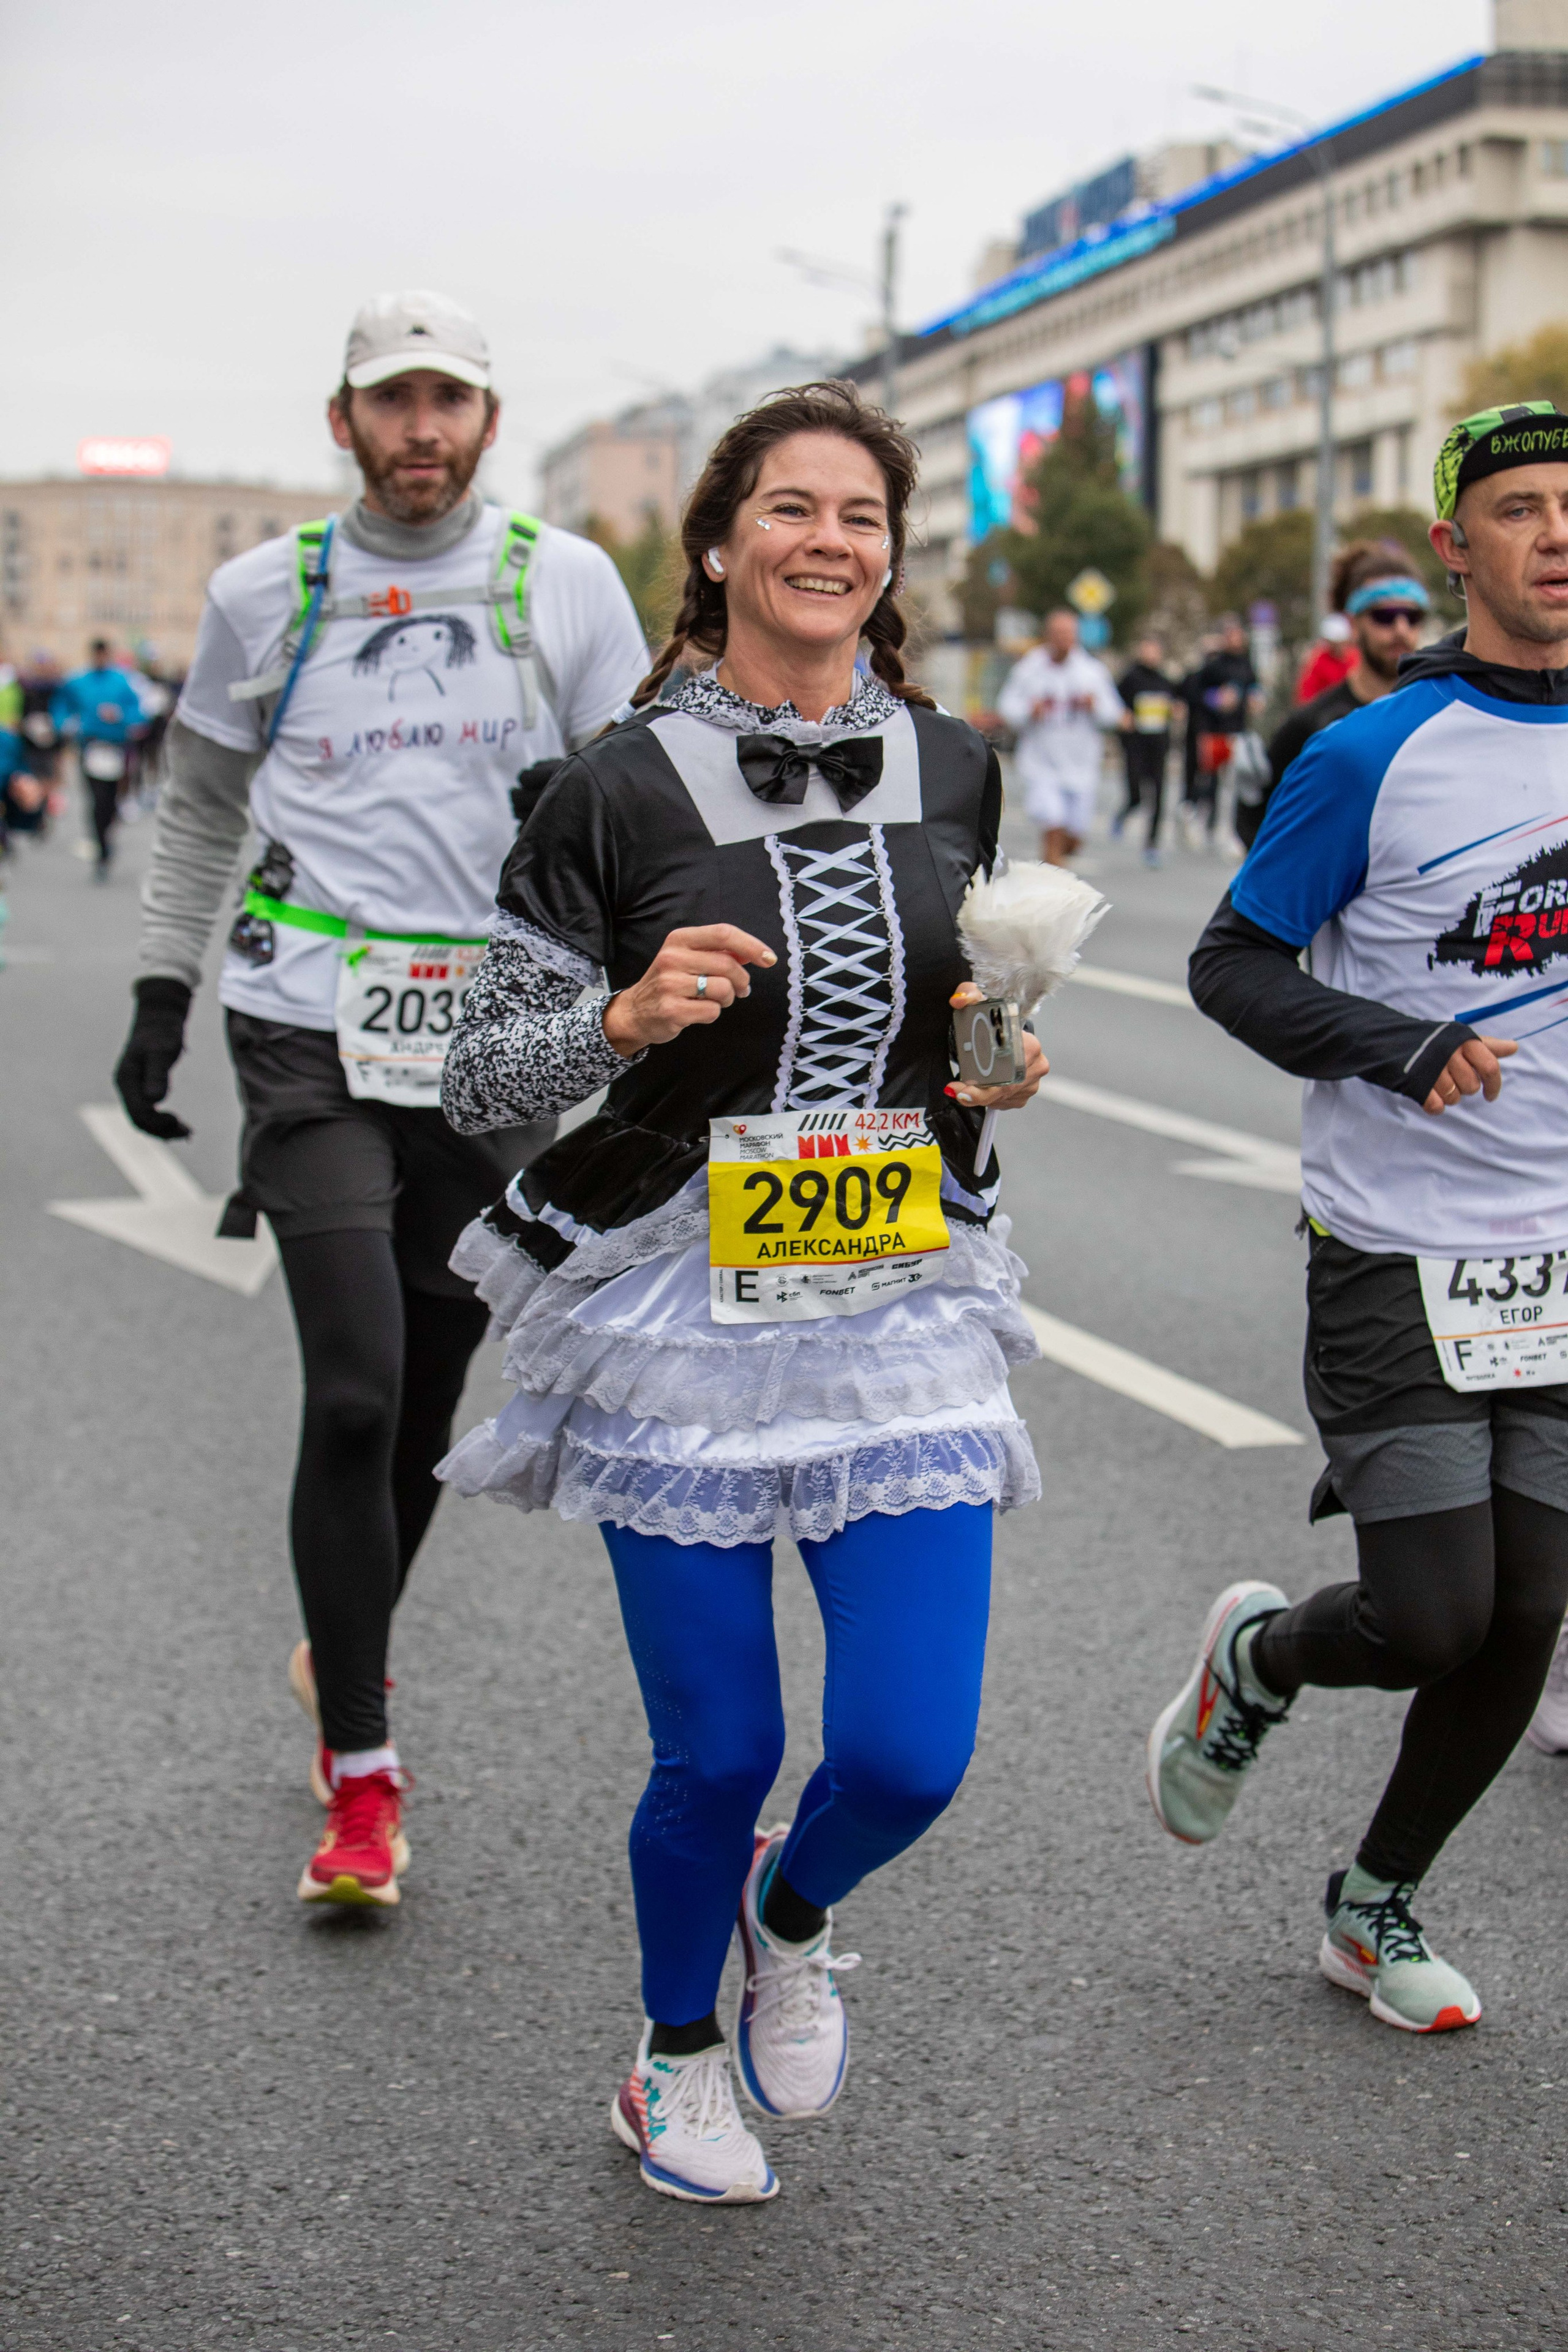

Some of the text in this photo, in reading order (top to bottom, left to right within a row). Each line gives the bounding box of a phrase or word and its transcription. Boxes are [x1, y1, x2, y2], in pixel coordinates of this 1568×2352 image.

[1472, 878, 1568, 938] FOR
[361, 986, 470, 1035] 203
[854, 1113, 888, 1133] 42,2
[739, 1133, 783, 1143] МОСКОВСКИЙ
[743, 1162, 912, 1234] 2909
[757, 1232, 906, 1259] АЛЕКСАНДРА
[820, 1286, 856, 1295] FONBET
[881, 1277, 907, 1287] МАГНИТ
[1500, 1306, 1542, 1324] ЕГОР
[1454, 1340, 1472, 1371] F
